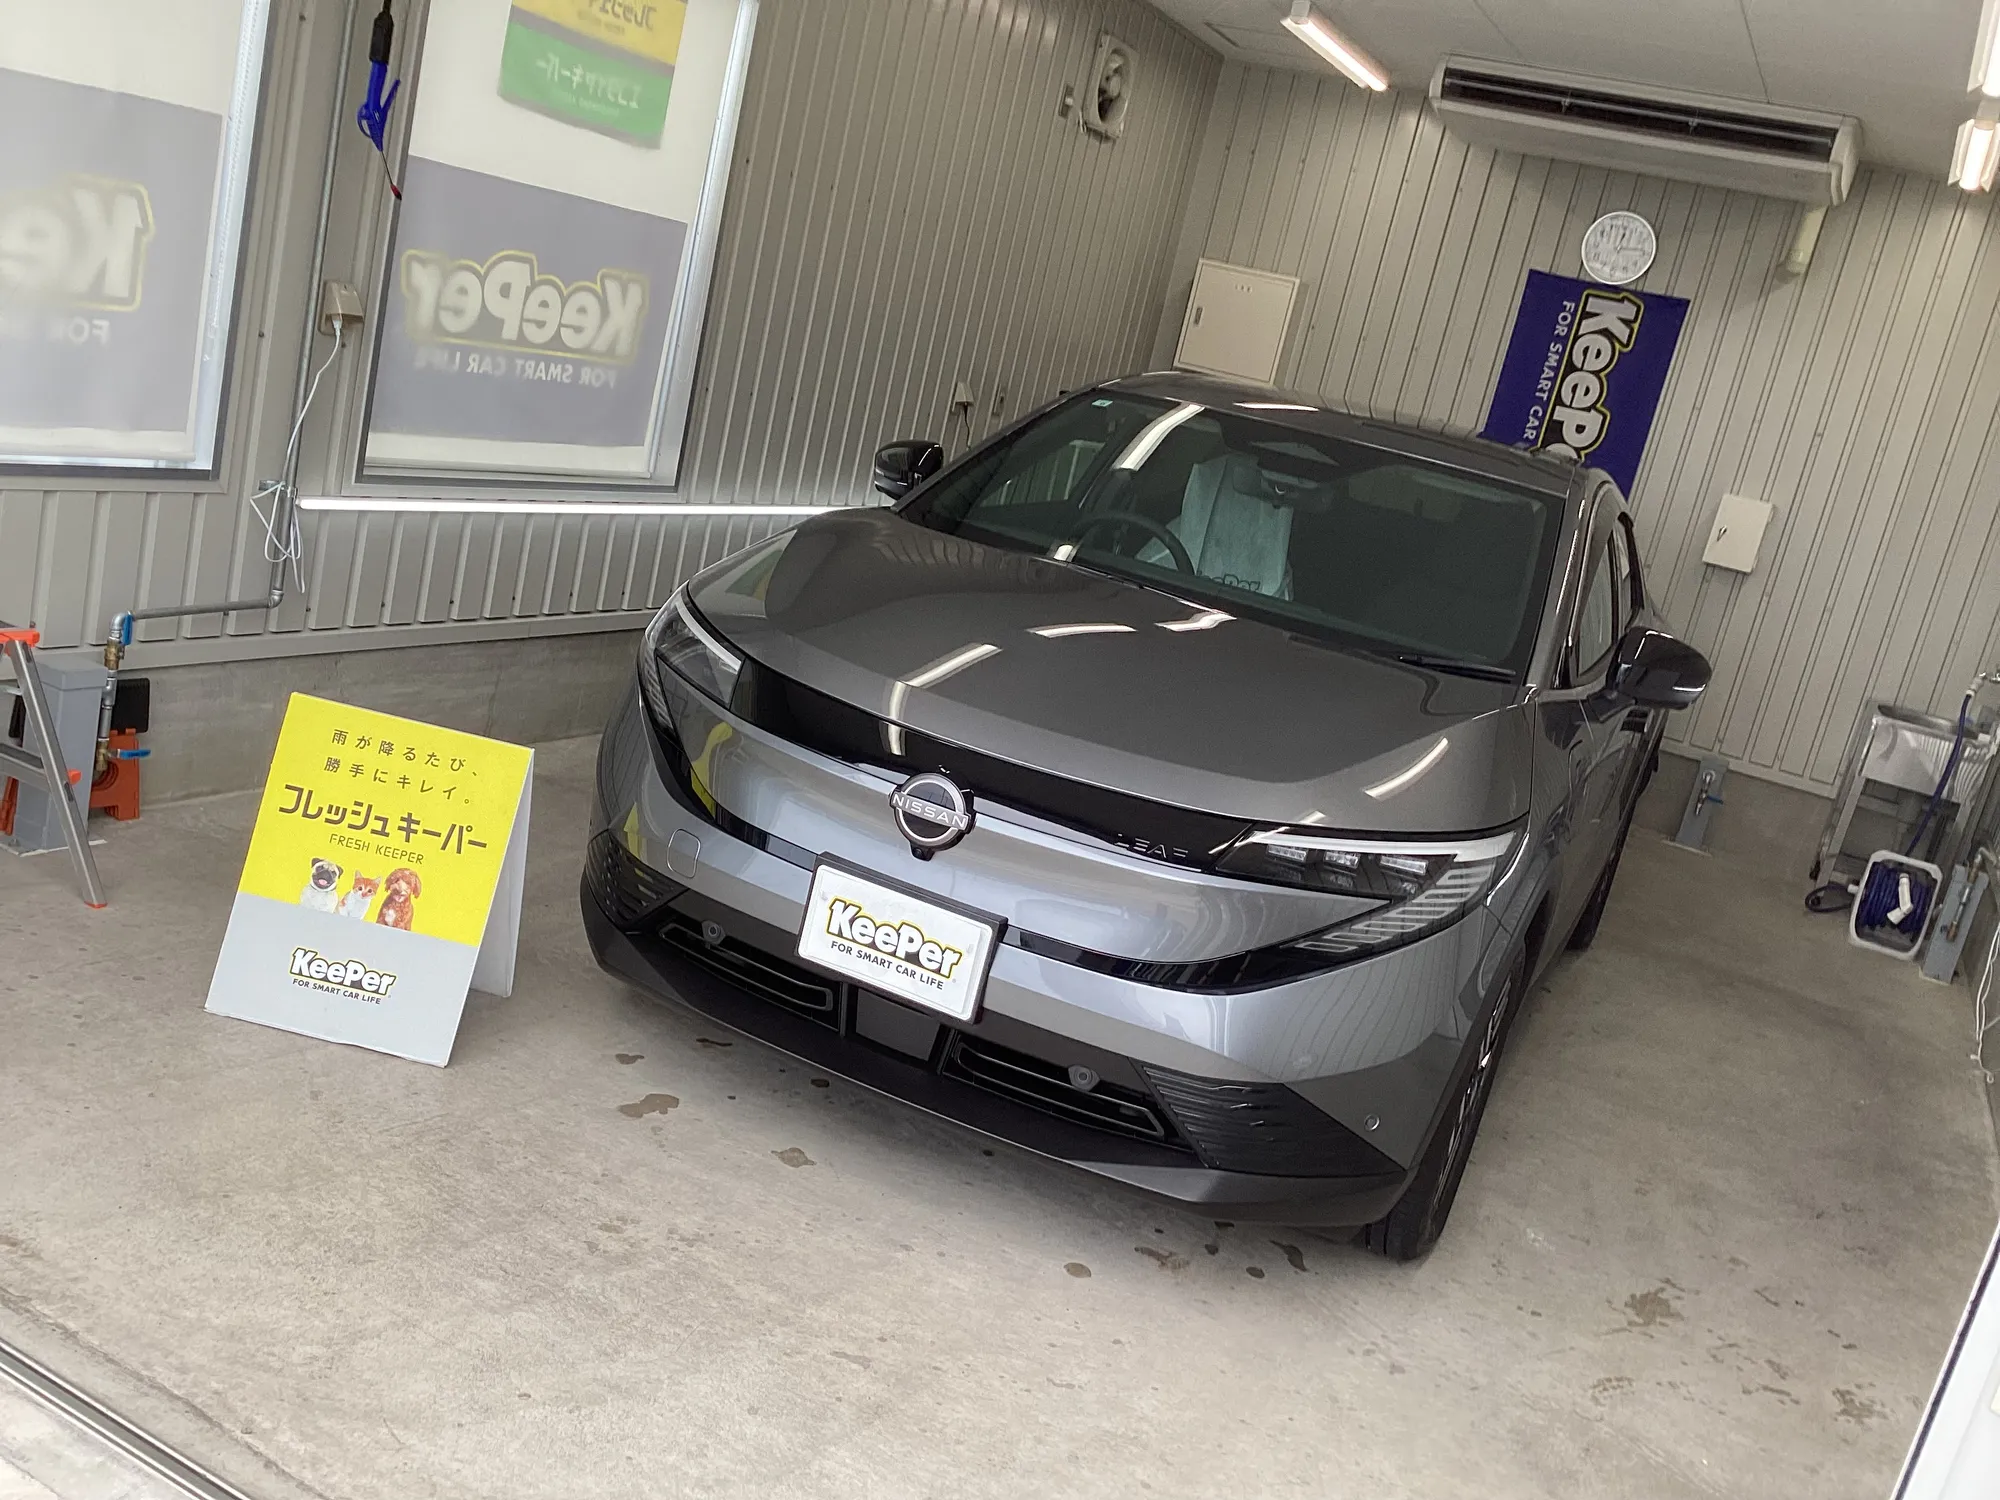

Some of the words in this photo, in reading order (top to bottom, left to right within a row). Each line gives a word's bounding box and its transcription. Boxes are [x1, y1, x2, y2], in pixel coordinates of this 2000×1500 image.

[1554, 300, 1575, 337] FOR
[1535, 342, 1562, 401] SMART
[1523, 405, 1543, 440] CAR
[331, 728, 479, 777] 雨が降るたび、
[323, 757, 470, 805] 勝手にキレイ。
[278, 784, 488, 855] フレッシュキーパー
[892, 793, 968, 830] NISSAN
[329, 833, 370, 852] FRESH
[375, 845, 424, 865] KEEPER
[826, 897, 963, 979] KeePer
[290, 947, 396, 996] KeePer
[830, 940, 853, 955] FOR
[856, 950, 893, 969] SMART
[895, 964, 917, 980] CAR
[920, 973, 944, 990] LIFE
[292, 978, 310, 988] FOR
[312, 982, 340, 995] SMART
[342, 990, 359, 1000] CAR
[362, 994, 382, 1005] LIFE
